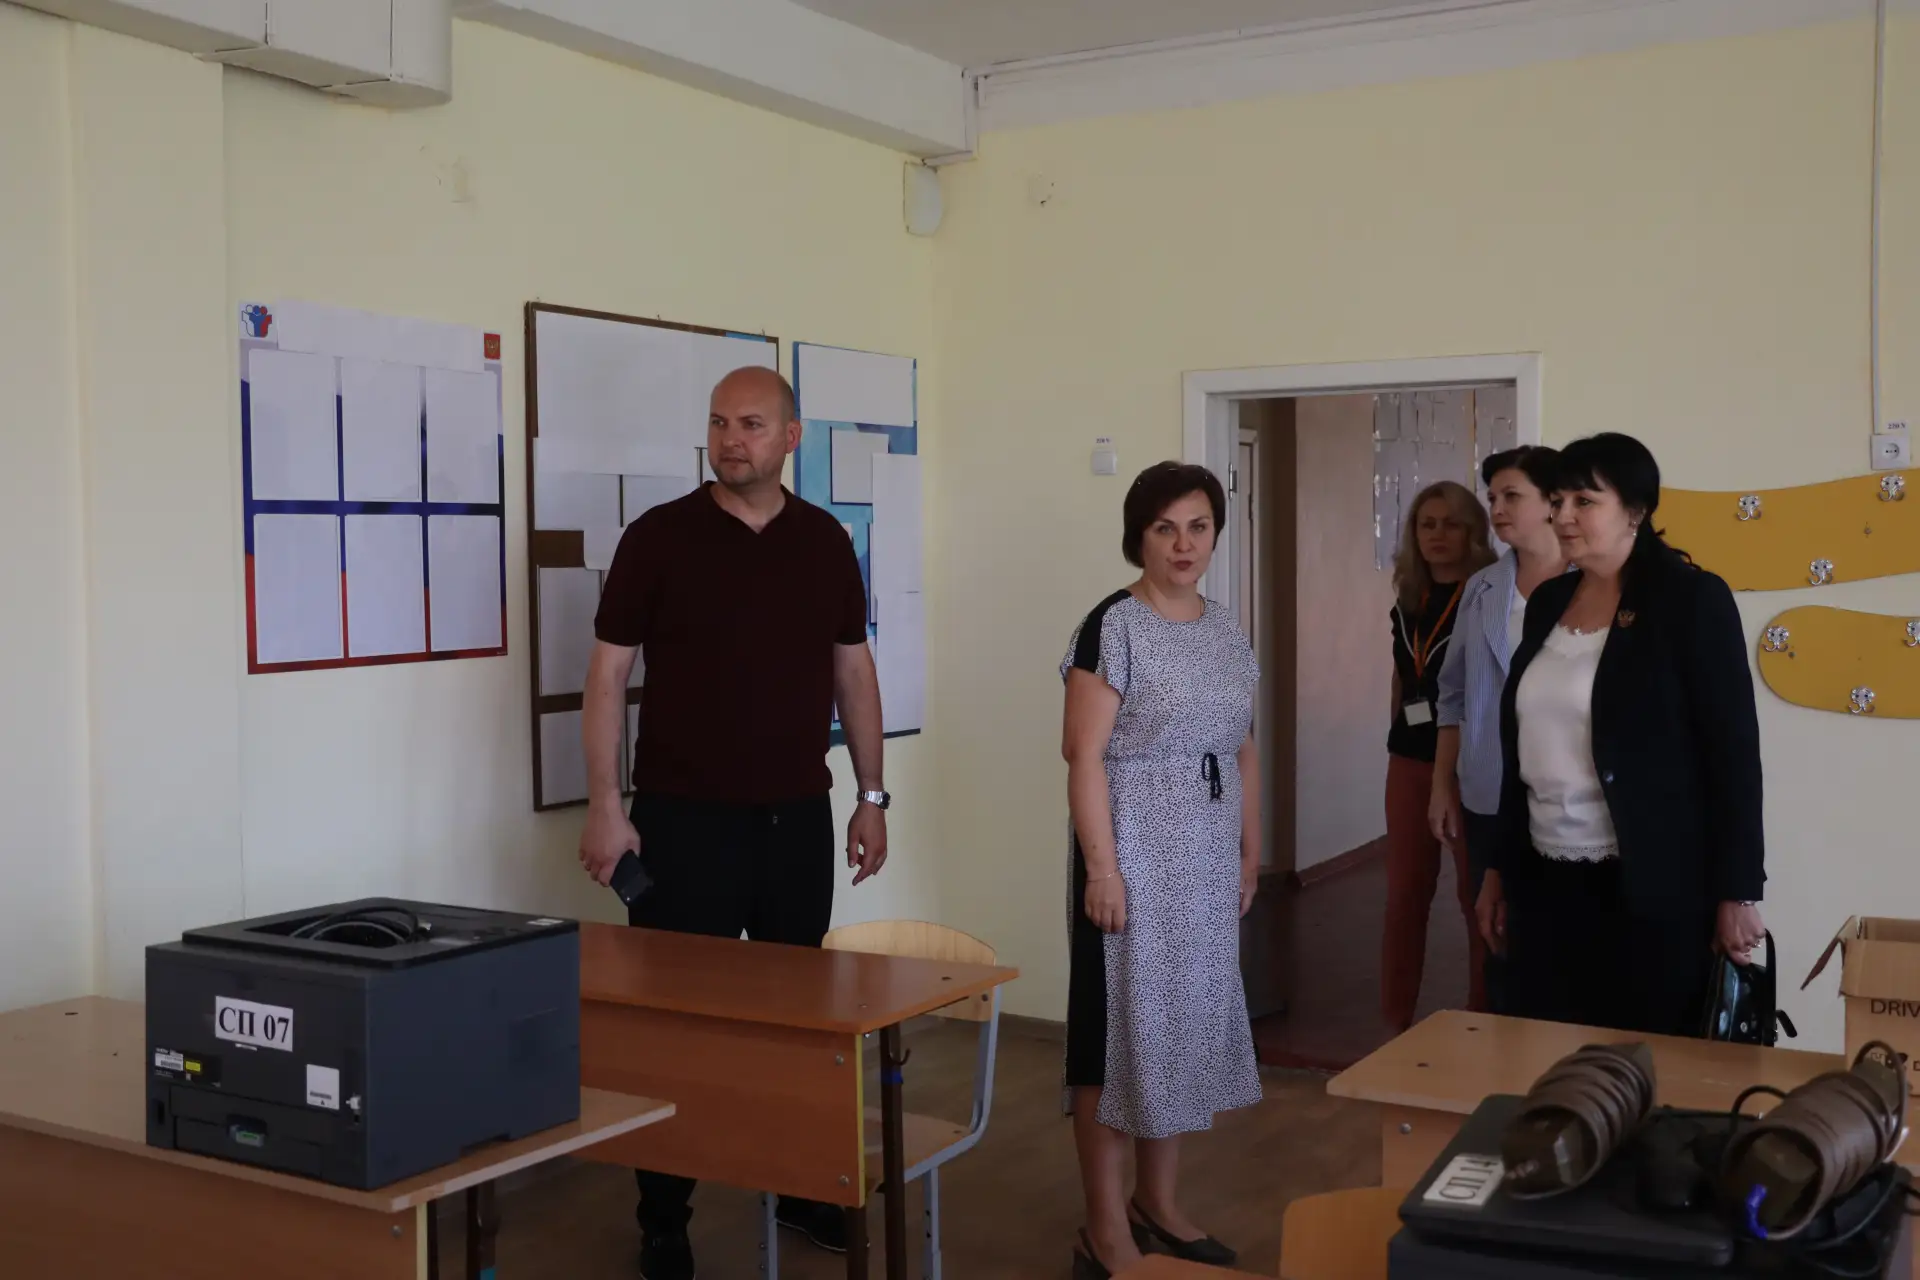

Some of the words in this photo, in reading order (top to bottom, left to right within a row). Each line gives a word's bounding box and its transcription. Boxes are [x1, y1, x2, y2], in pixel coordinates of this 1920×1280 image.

[218, 1006, 256, 1038] СП
[263, 1014, 291, 1044] 07
[1439, 1177, 1487, 1200] СП
